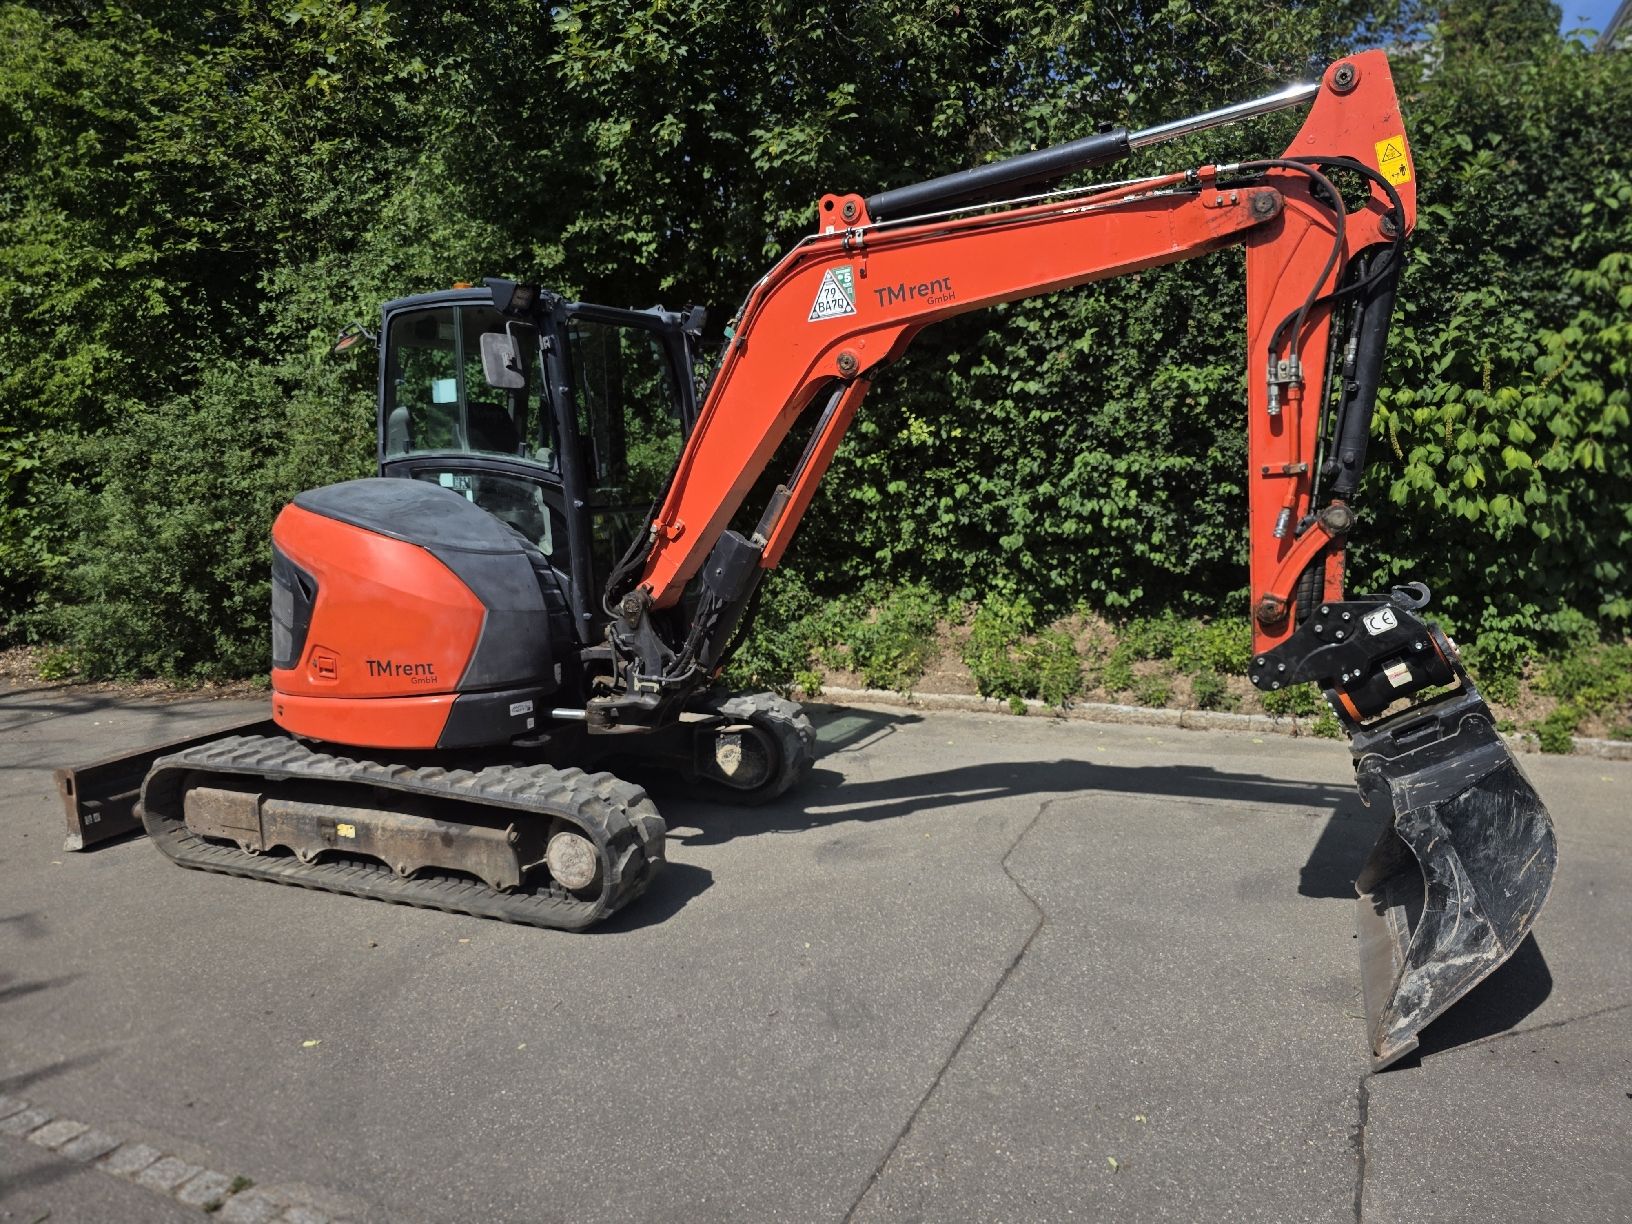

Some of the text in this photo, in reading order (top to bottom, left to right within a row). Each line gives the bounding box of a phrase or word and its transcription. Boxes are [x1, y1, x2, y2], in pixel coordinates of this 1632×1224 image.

[824, 287, 837, 299] 79
[927, 291, 956, 305] GmbH
[411, 676, 438, 685] GmbH
